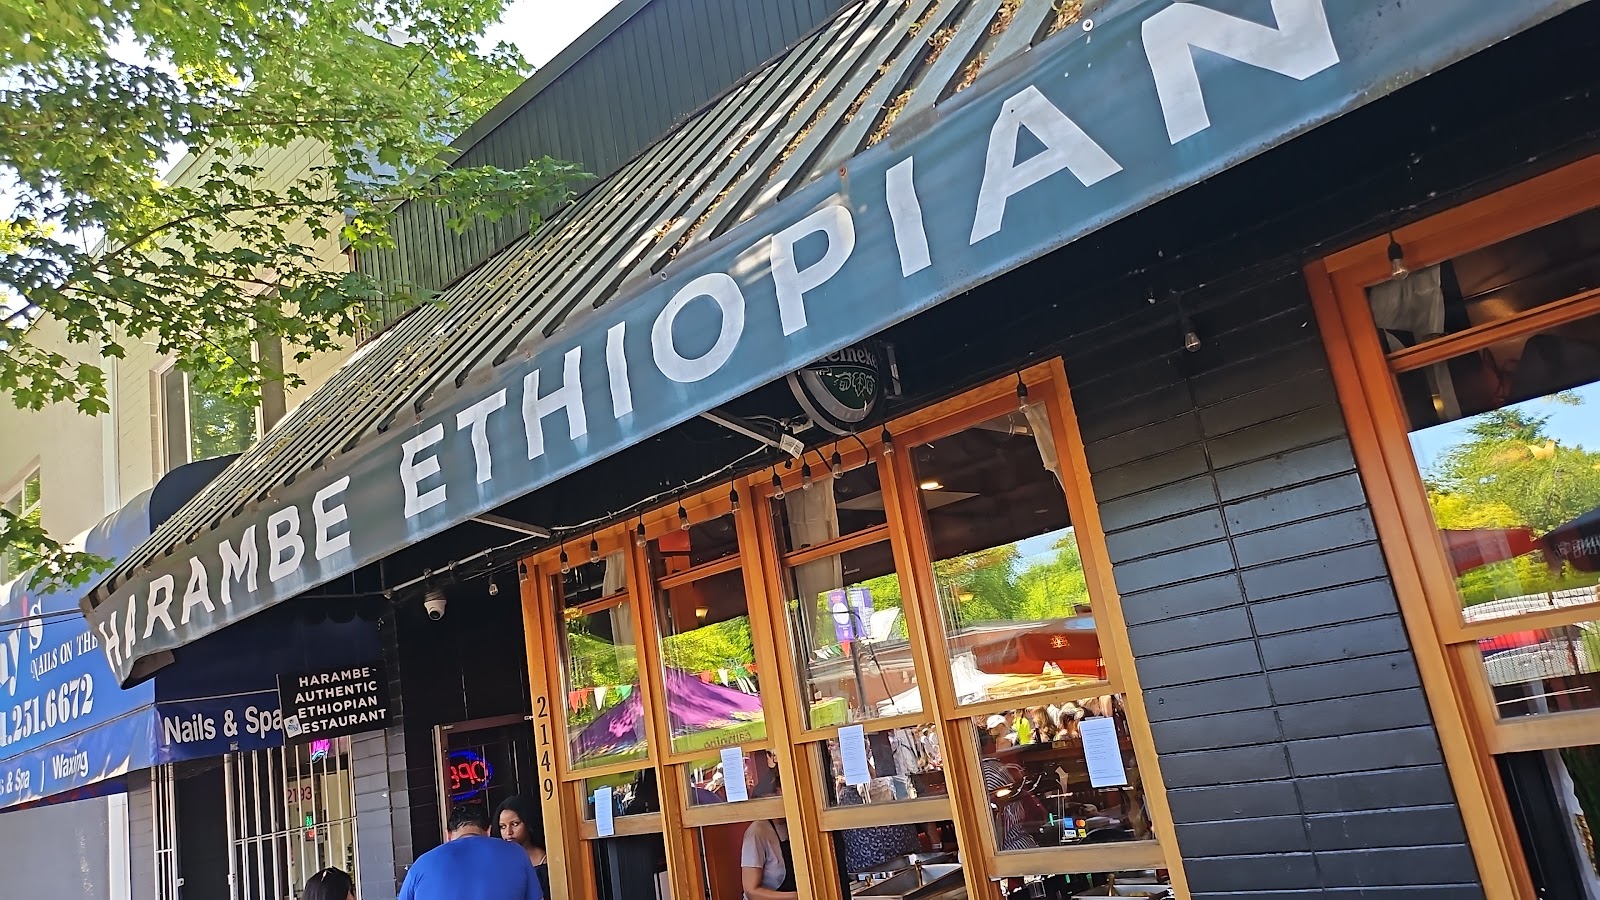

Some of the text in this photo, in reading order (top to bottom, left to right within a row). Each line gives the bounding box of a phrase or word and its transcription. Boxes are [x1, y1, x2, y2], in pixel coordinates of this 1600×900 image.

[99, 0, 1340, 673] HARAMBE ETHIOPIAN
[30, 648, 58, 681] NAILS
[60, 640, 73, 665] ON
[298, 666, 371, 688] HARAMBE
[294, 680, 378, 704] AUTHENTIC
[297, 695, 378, 719] ETHIOPIAN
[164, 705, 283, 745] Nails & Spa
[300, 708, 387, 734] ESTAURANT
[536, 696, 554, 801] 2149
[52, 749, 89, 778] Waxing
[6, 771, 14, 793] &
[15, 767, 31, 793] Spa
